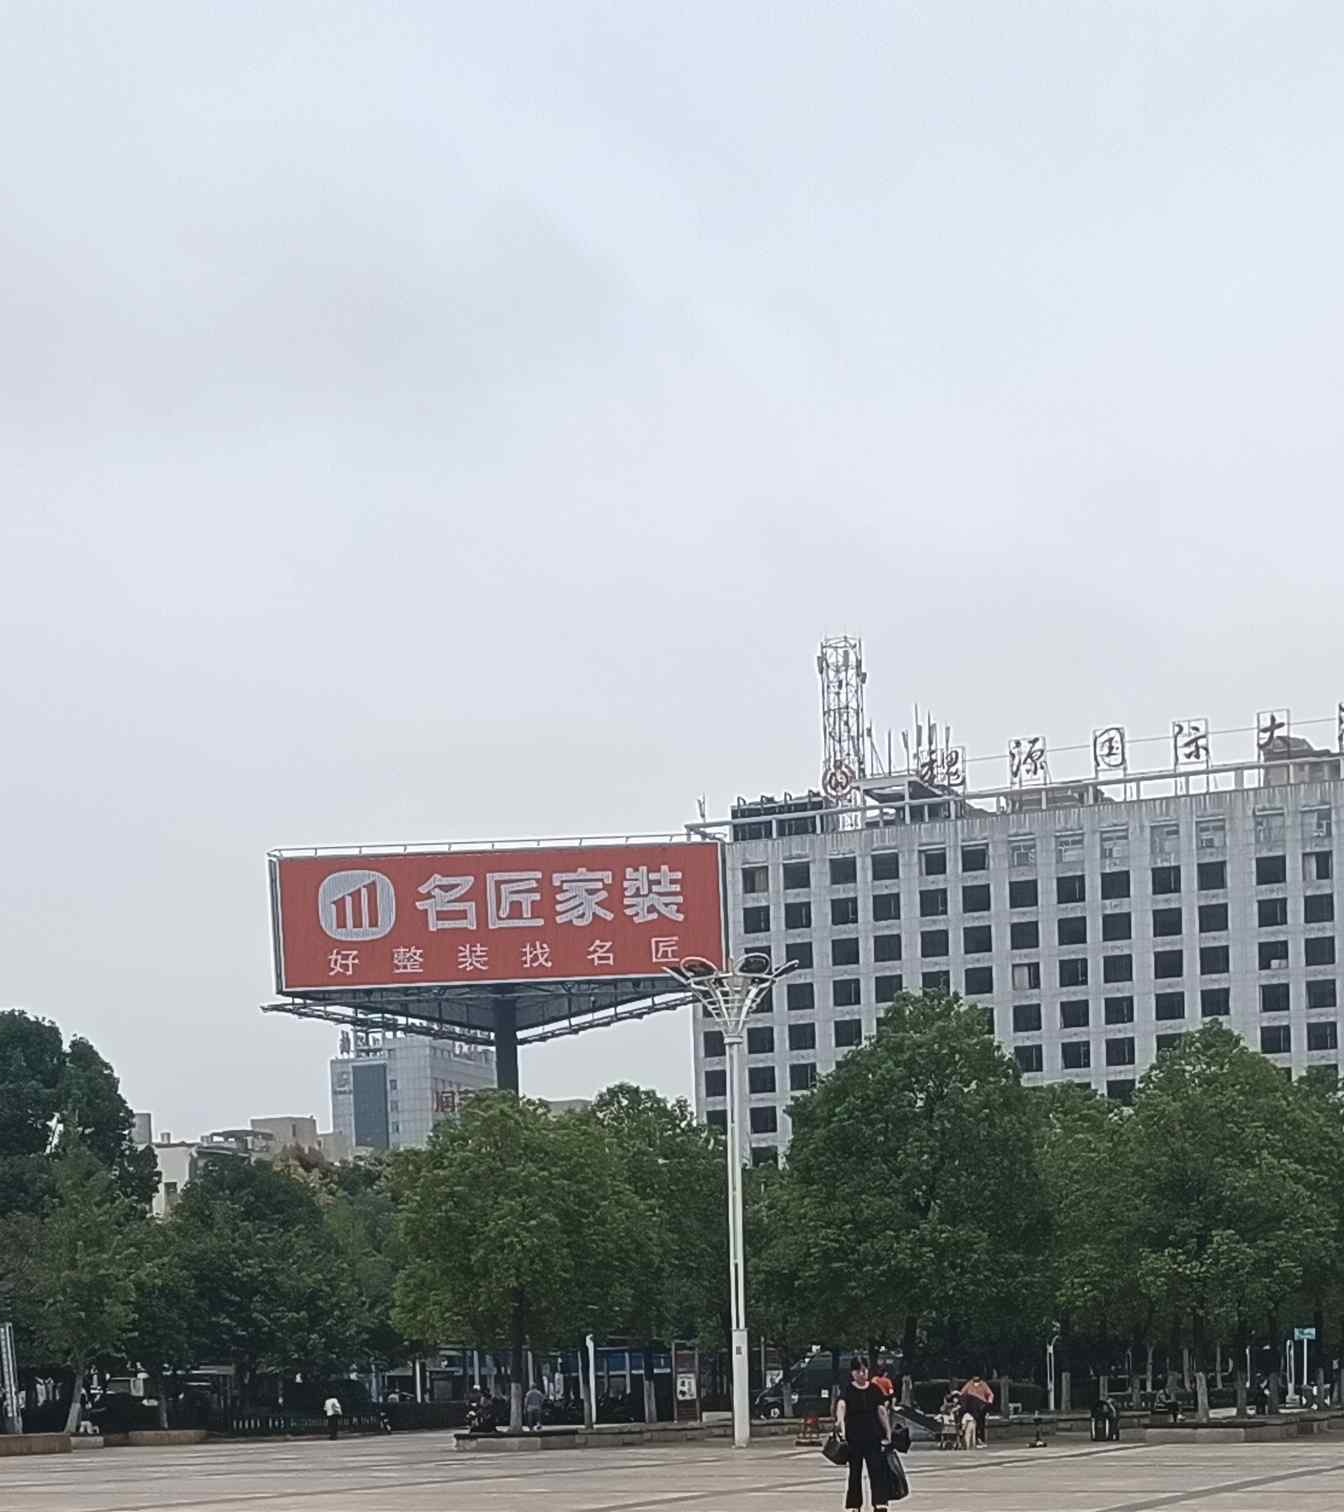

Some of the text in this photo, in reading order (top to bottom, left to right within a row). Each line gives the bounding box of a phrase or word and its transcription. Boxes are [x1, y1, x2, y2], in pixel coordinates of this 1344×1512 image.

[327, 936, 681, 977] 好整装找名匠
